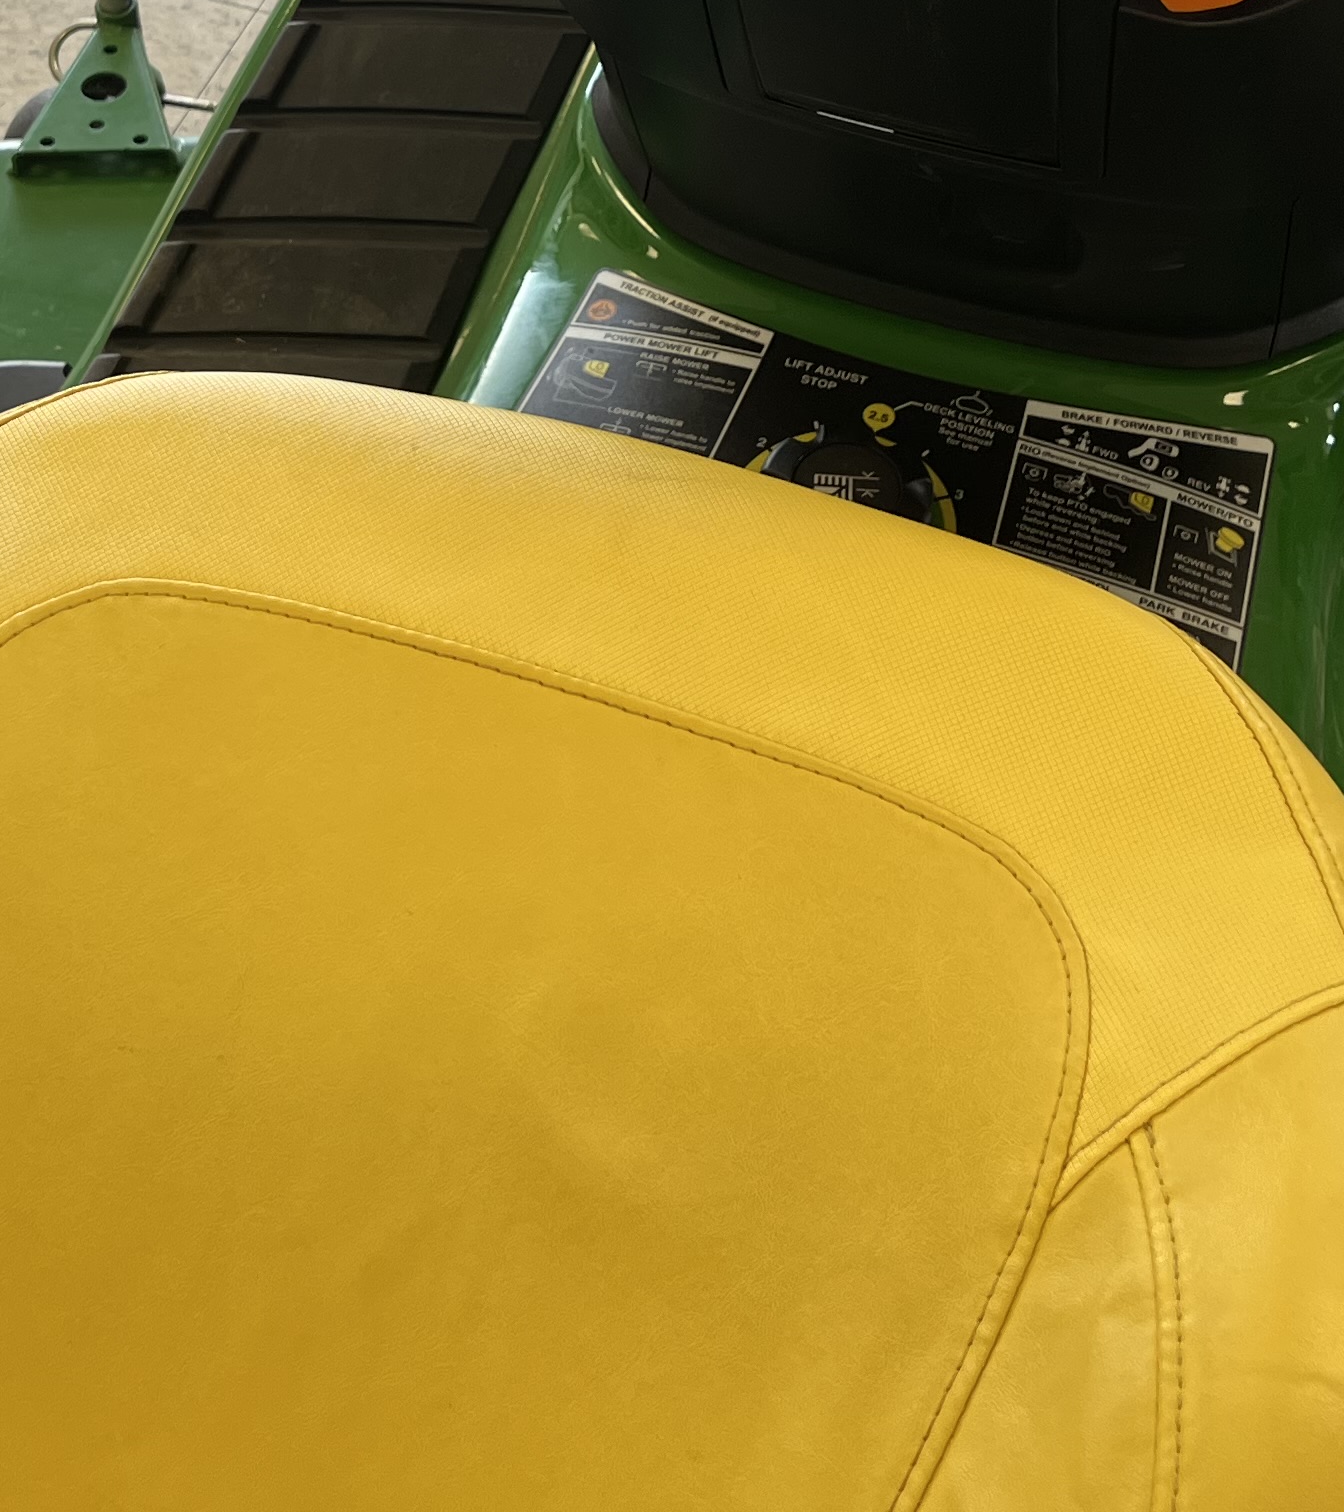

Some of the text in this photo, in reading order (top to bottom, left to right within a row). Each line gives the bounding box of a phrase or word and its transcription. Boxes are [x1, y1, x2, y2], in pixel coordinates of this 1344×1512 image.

[620, 280, 668, 304] TRACTION
[668, 299, 705, 318] ASSIST
[604, 333, 719, 359] POWER MOWER LIFT
[639, 351, 710, 372] RAISE MOWER
[784, 357, 869, 385] LIFT ADJUST
[800, 374, 837, 390] STOP
[607, 406, 684, 428] LOWER MOWER
[867, 410, 889, 424] 2.5
[924, 402, 1015, 434] DECK LEVELING
[940, 417, 995, 439] POSITION
[1061, 409, 1103, 426] BRAKE
[1113, 418, 1173, 436] FORWARD
[1183, 428, 1238, 446] REVERSE
[756, 437, 768, 449] 2
[1092, 445, 1119, 461] FWD
[954, 489, 964, 500] 3
[1187, 477, 1211, 492] REV
[1028, 487, 1041, 497] To
[1067, 498, 1088, 511] PTO
[1176, 492, 1254, 529] MOWER/PTO
[1173, 552, 1233, 579] MOWER ON
[1168, 574, 1230, 601] MOWER OFF
[1138, 597, 1230, 636] PARK BRAKE
